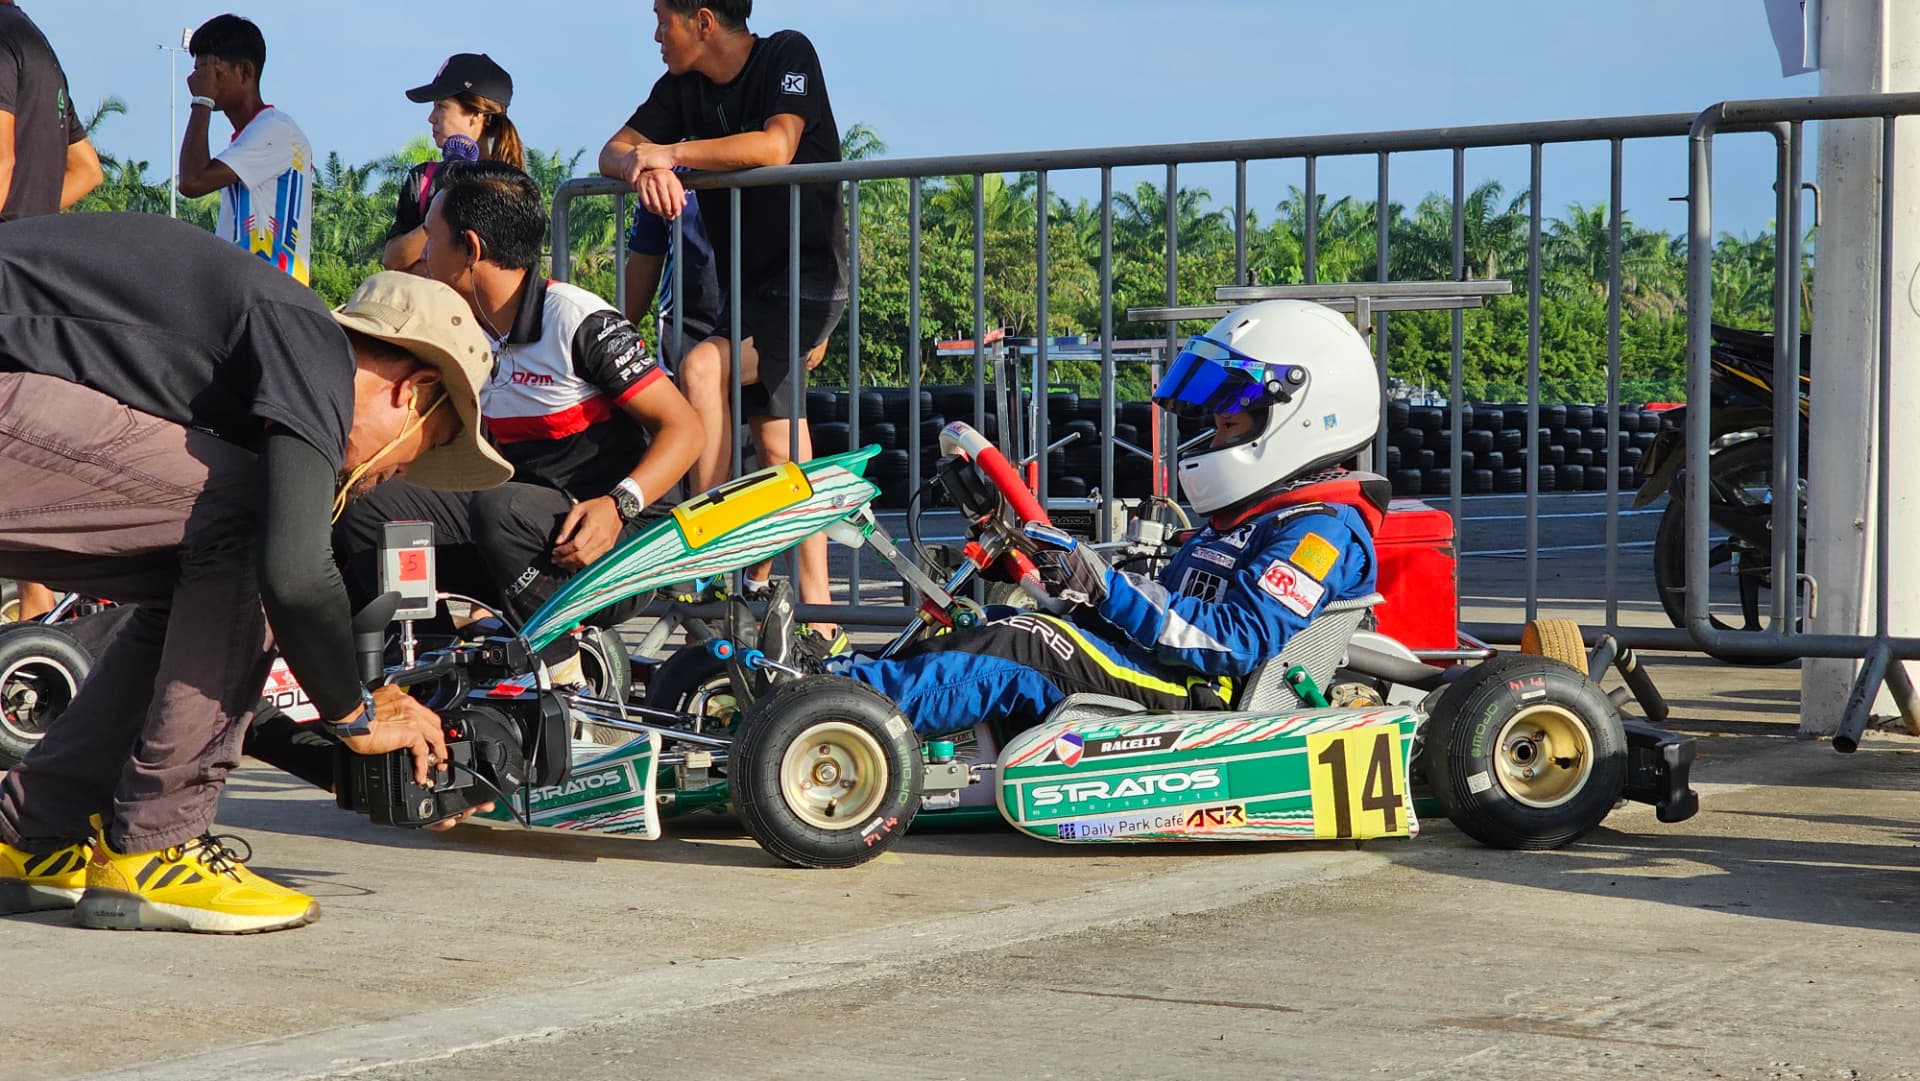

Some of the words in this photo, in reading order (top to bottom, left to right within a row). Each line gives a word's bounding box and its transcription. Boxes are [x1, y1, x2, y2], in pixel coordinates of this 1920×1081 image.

[407, 554, 418, 572] 5
[1101, 736, 1162, 752] RACELIS
[529, 769, 622, 804] STRATOS
[1031, 768, 1222, 806] STRATOS
[1318, 733, 1403, 838] 14
[1082, 824, 1114, 837] Daily
[1119, 819, 1150, 833] Park
[1154, 813, 1184, 829] Café
[1186, 804, 1245, 828] AGR
